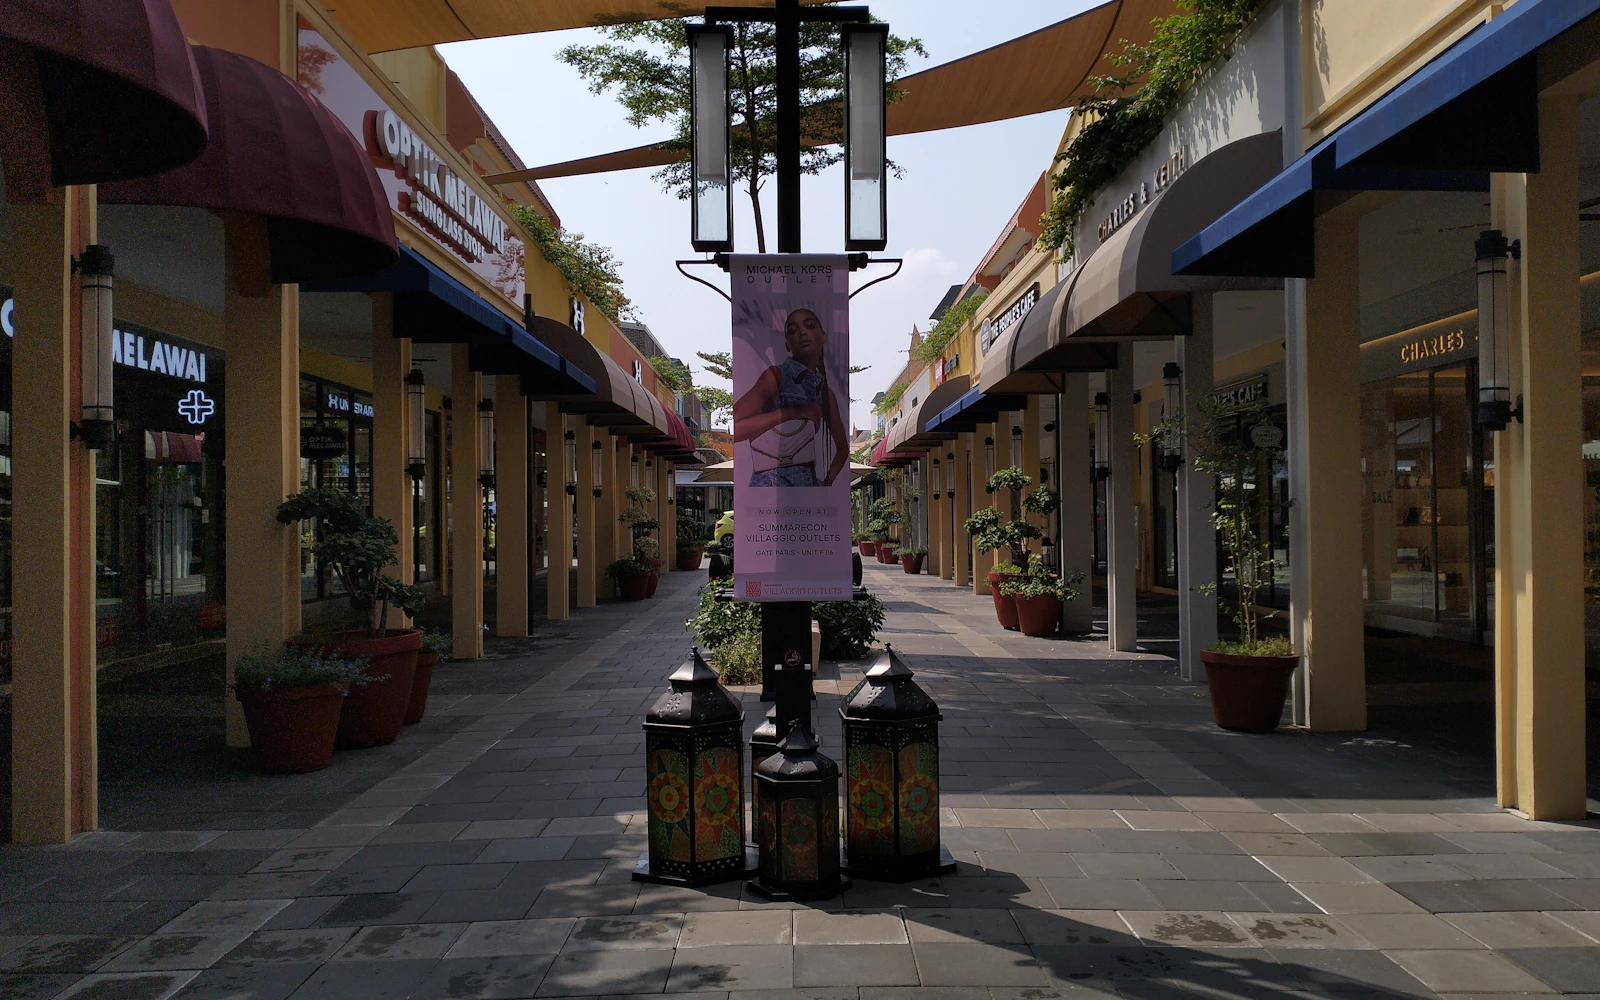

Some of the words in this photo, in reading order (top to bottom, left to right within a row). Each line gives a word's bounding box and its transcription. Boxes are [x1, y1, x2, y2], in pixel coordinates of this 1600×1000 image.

[384, 109, 442, 199] OPTIK
[444, 172, 504, 254] MELAWAI
[1097, 193, 1135, 242] CHARLES
[1140, 182, 1149, 204] &
[1153, 145, 1188, 194] KEITH
[416, 190, 464, 247] SUNGLASS
[746, 265, 797, 274] MICHAEL
[801, 265, 832, 274] KORS
[747, 275, 833, 283] OUTLET
[1400, 328, 1465, 363] CHARLES
[308, 435, 333, 443] OPTIK
[758, 523, 827, 532] SUMMARECON
[745, 534, 797, 542] VILLAGGIO
[799, 534, 841, 542] OUTLETS
